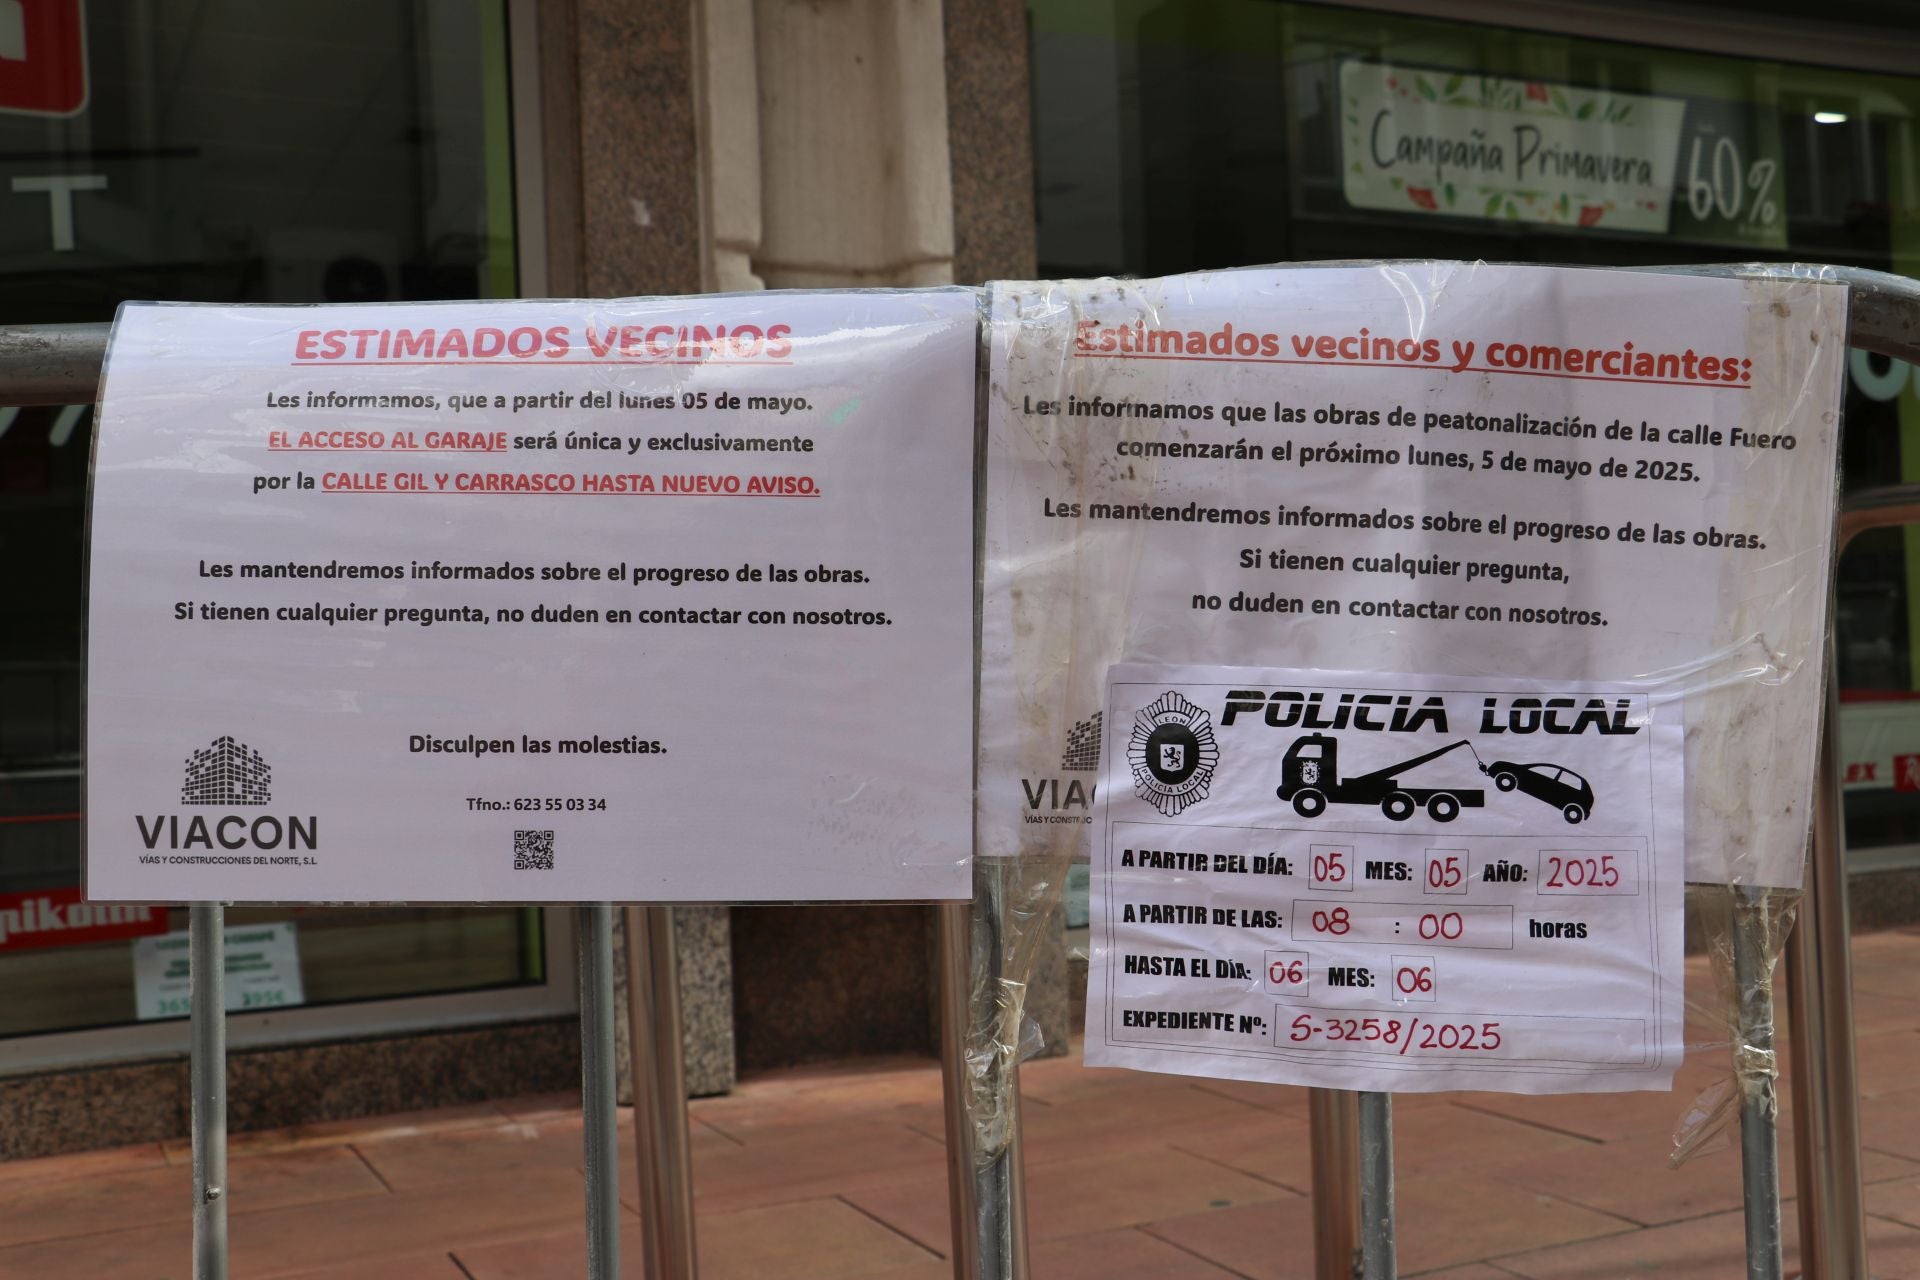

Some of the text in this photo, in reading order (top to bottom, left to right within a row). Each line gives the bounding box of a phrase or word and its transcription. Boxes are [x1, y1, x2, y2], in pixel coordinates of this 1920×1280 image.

[1371, 109, 1652, 187] Campaña Primavera
[295, 324, 792, 359] ESTIMADOS VECINOS
[1075, 319, 1753, 383] Estimados vecinos y comerciantes:
[267, 391, 813, 415] Les informamos, que a partir del lunes 05 de mayo.
[1023, 396, 1797, 450] Les informamos que las obras de peatonalización de la calle Fuero
[268, 431, 814, 455] EL ACCESO AL GARAJE será única y exclusivamente
[1116, 438, 1700, 483] comenzarán el próximo lunes, 5 de mayo de 2025.
[253, 471, 820, 494] por la CALLE GIL Y CARRASCO HASTA NUEVO AVISO.
[1044, 498, 1766, 550] Les mantendremos informados sobre el progreso de las obras.
[199, 560, 870, 586] Les mantendremos informados sobre el progreso de las obras.
[1240, 548, 1569, 584] Si tienen cualquier pregunta,
[174, 602, 893, 627] Si tienen cualquier pregunta, no duden en contactar con nosotros.
[1192, 591, 1608, 627] no duden en contactar con nosotros.
[1220, 690, 1640, 735] POLICIA LOCAL
[409, 734, 667, 758] Disculpen las molestias.
[1021, 779, 1097, 808] VIA
[1142, 768, 1204, 793] POLICIA LOCAL
[466, 798, 606, 811] Tfno.: 623 55 03 34
[1024, 814, 1043, 824] VÍAS
[1043, 816, 1049, 824] Y
[135, 815, 317, 850] VIACON
[139, 854, 160, 864] VÍAS
[162, 856, 168, 864] Y
[169, 856, 252, 865] CONSTRUCCIONES
[253, 856, 268, 865] DEL
[270, 857, 302, 866] NORTE,
[1121, 849, 1619, 888] A PARTIR DEL DÍA: 05 MES: 05 AÑO: 2025
[1123, 904, 1588, 940] A PARTIR DE LAS: 08 : 00 horas
[1124, 954, 1432, 993] HASTA EL DÍA: 06 MES: 06
[1123, 1010, 1501, 1055] EXPEDIENTE Nº: S-3258/2025
